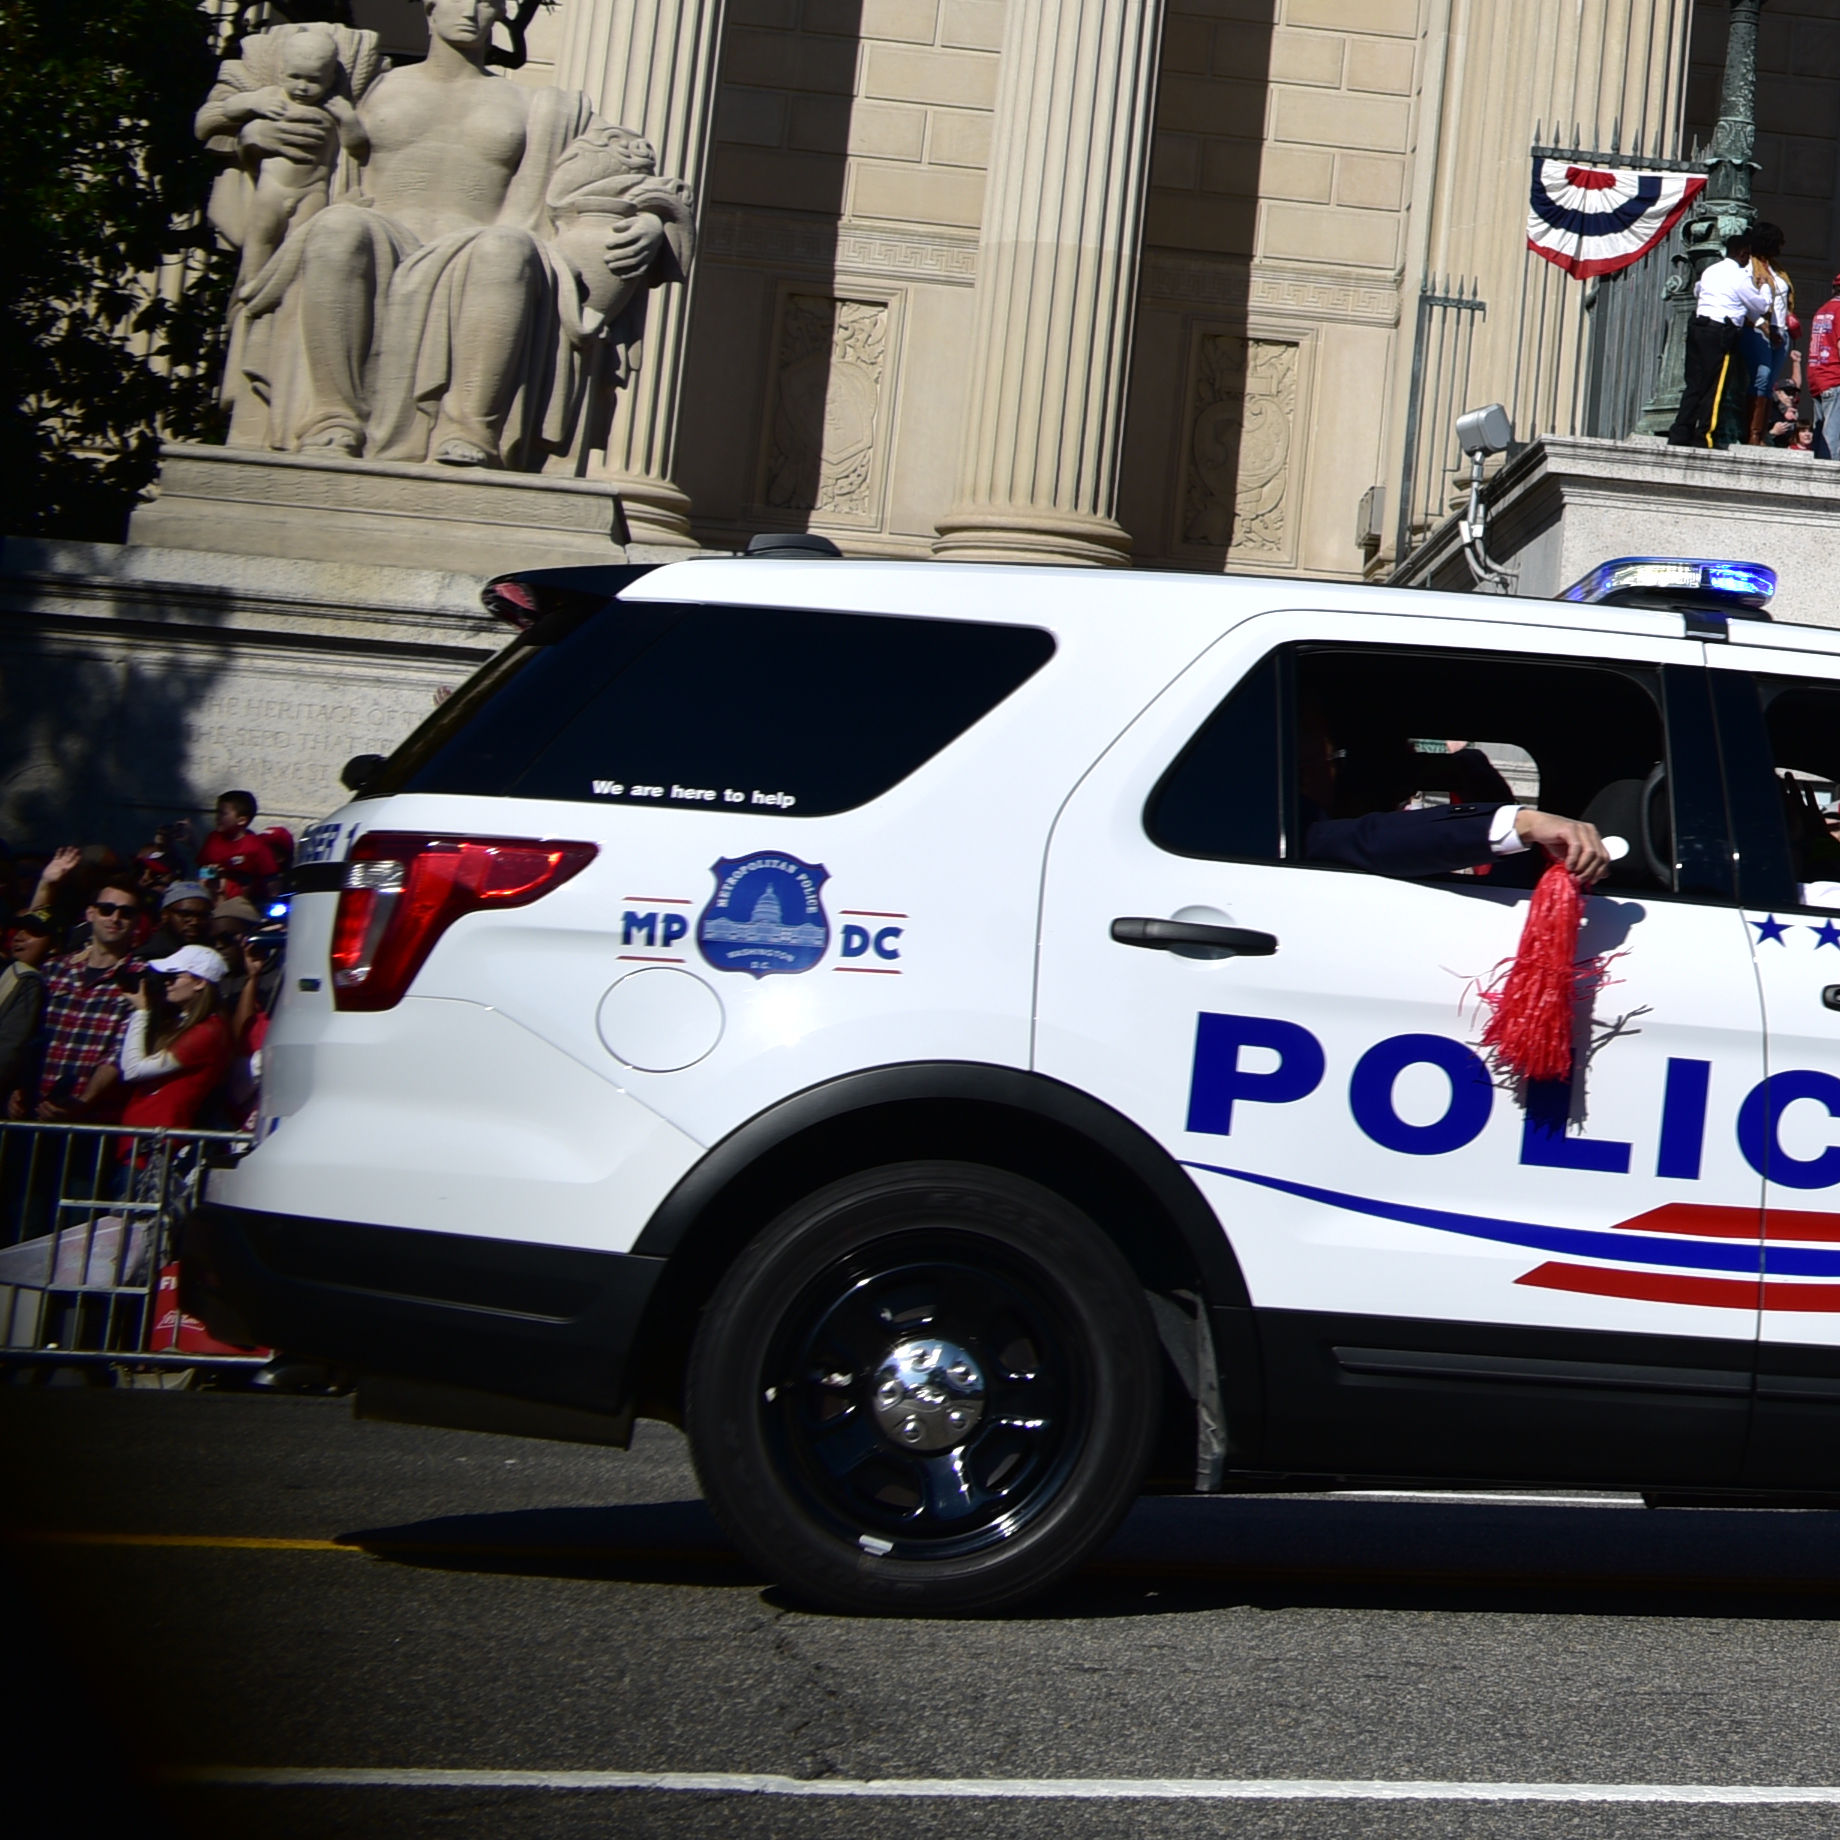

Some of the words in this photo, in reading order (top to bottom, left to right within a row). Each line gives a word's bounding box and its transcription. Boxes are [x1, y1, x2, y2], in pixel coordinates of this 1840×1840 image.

[592, 779, 625, 796] We
[630, 785, 664, 798] are
[670, 783, 715, 802] here
[723, 787, 746, 802] to
[750, 786, 797, 809] help
[795, 873, 819, 914] POLICE
[620, 910, 688, 948] MP
[839, 924, 904, 961] DC
